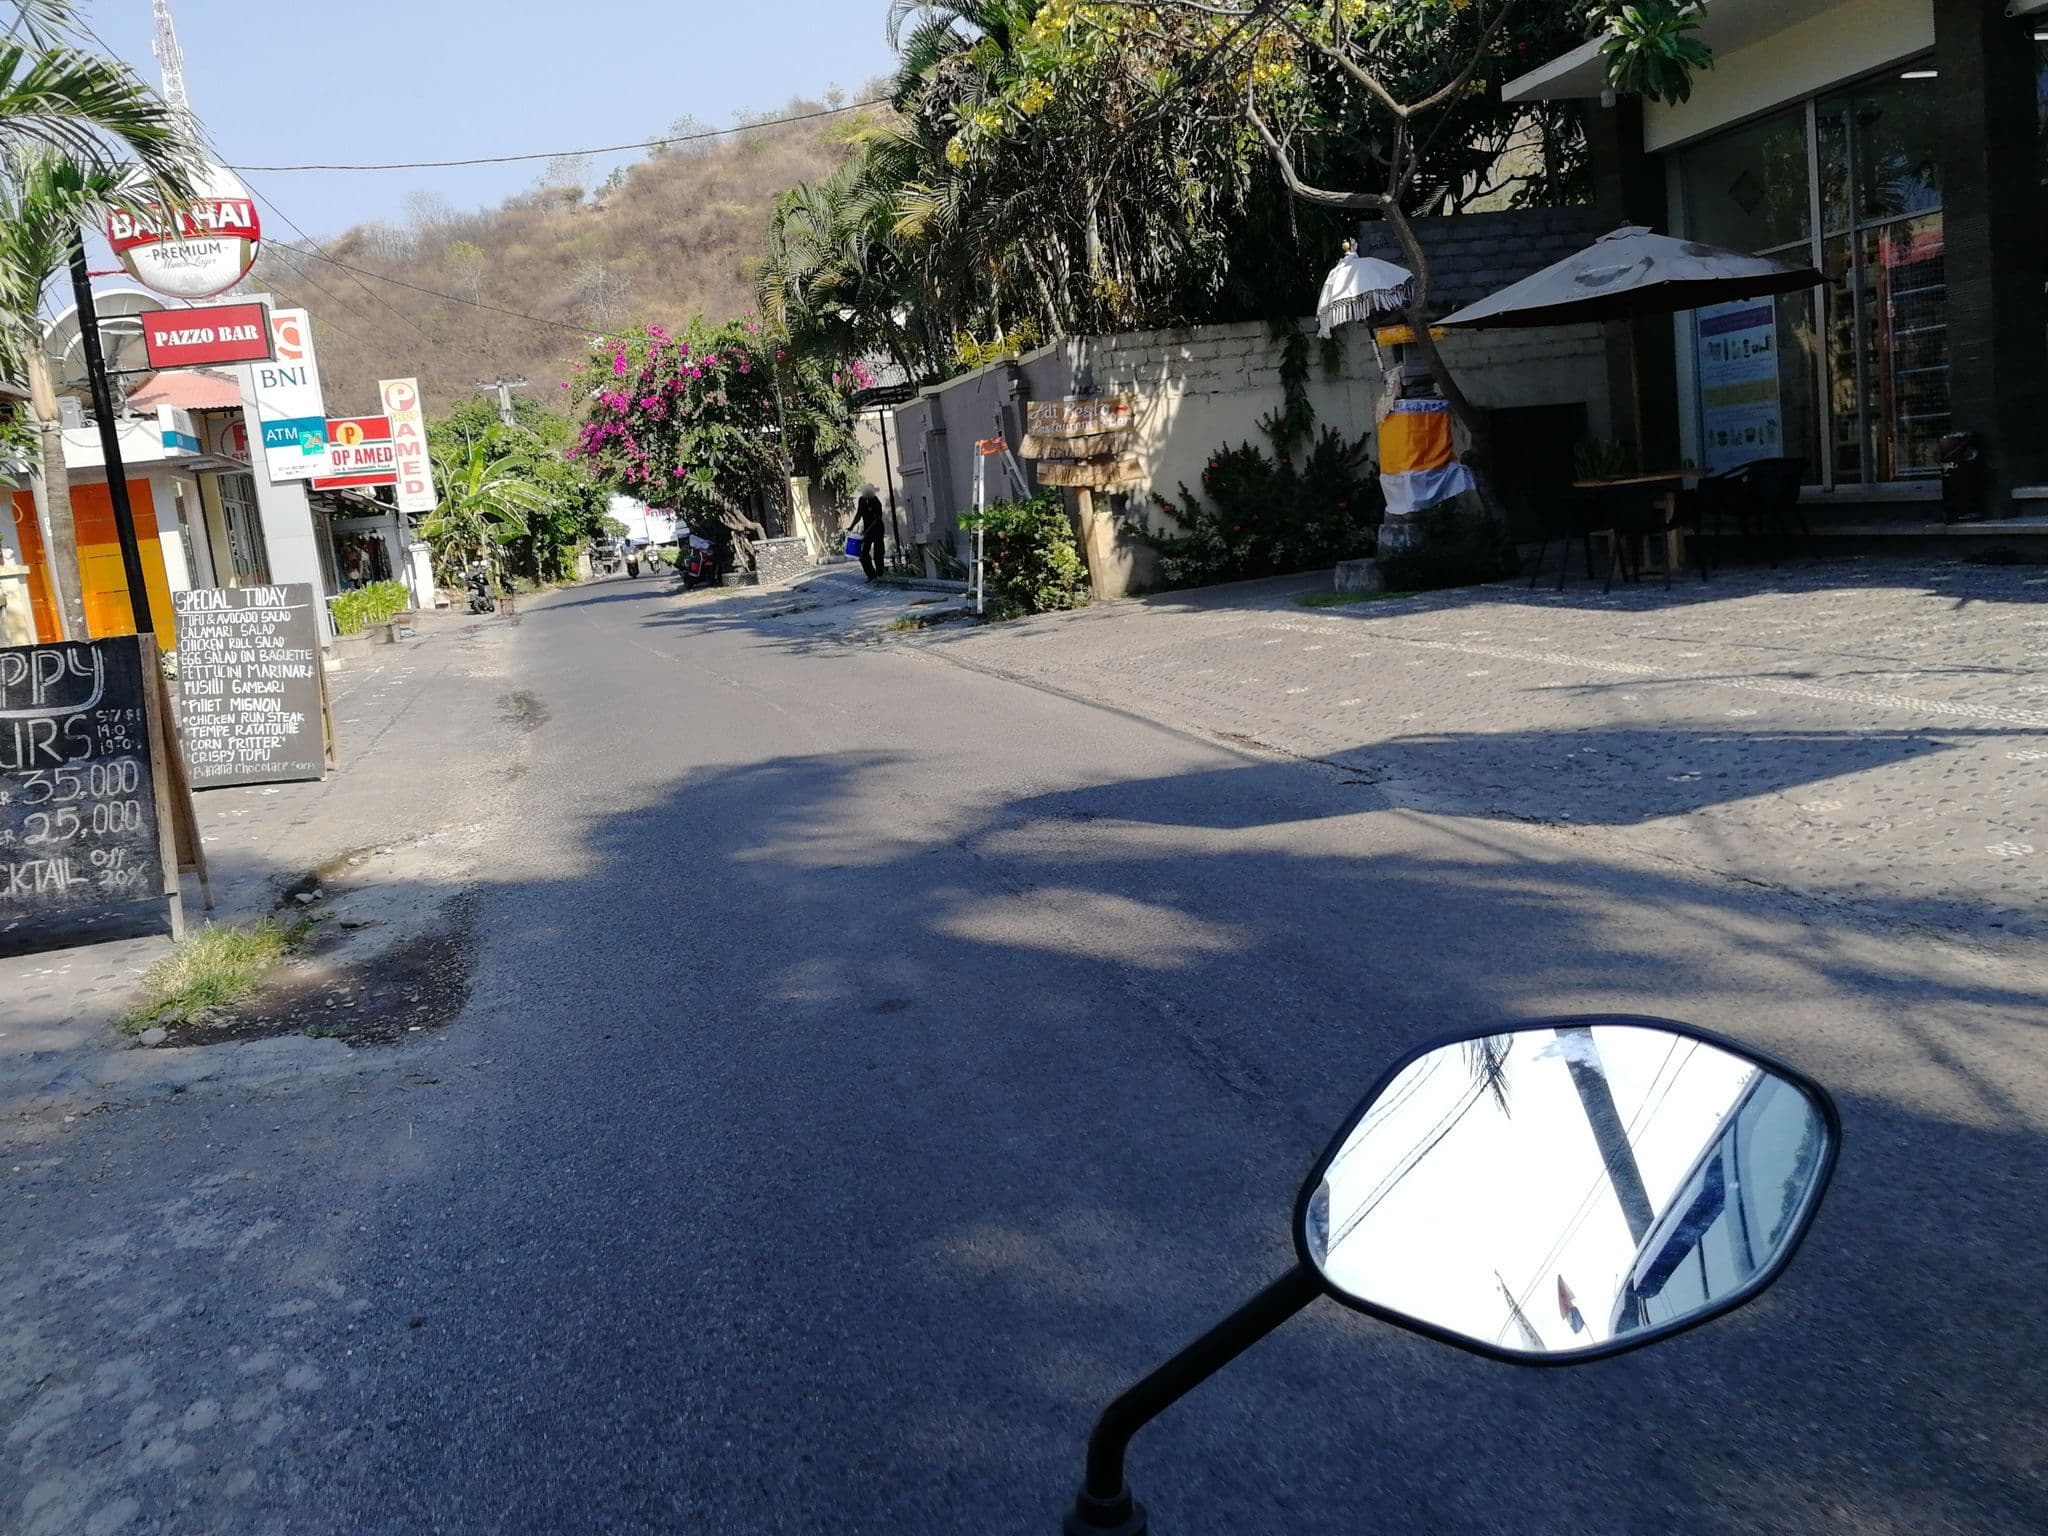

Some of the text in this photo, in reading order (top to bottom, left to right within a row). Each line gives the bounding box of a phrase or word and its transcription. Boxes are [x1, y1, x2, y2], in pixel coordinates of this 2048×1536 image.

[192, 203, 251, 229] HAI
[152, 242, 221, 261] PREMIUM
[154, 325, 259, 347] PAZZO BAR
[260, 366, 307, 389] BNI
[266, 427, 298, 441] ATM
[344, 426, 355, 445] P
[354, 446, 393, 465] AMED
[175, 586, 288, 612] SPECIAL TODAY
[177, 610, 291, 627] TOFU & AVOCADO SALAD
[240, 623, 276, 637] SALAD
[180, 635, 285, 653] CHICKEN ROLL SALAD
[181, 648, 313, 666] EGG SALAD ON BAGUETTE
[181, 664, 242, 680] FETTUCINI
[231, 679, 285, 695] GAMBARI
[230, 697, 281, 713] MIGNON
[188, 711, 305, 727] CHICKEN RUN STEAK
[189, 725, 231, 738] TEMPE
[190, 738, 222, 752] CORN
[190, 748, 271, 765] CRISPY TOFU
